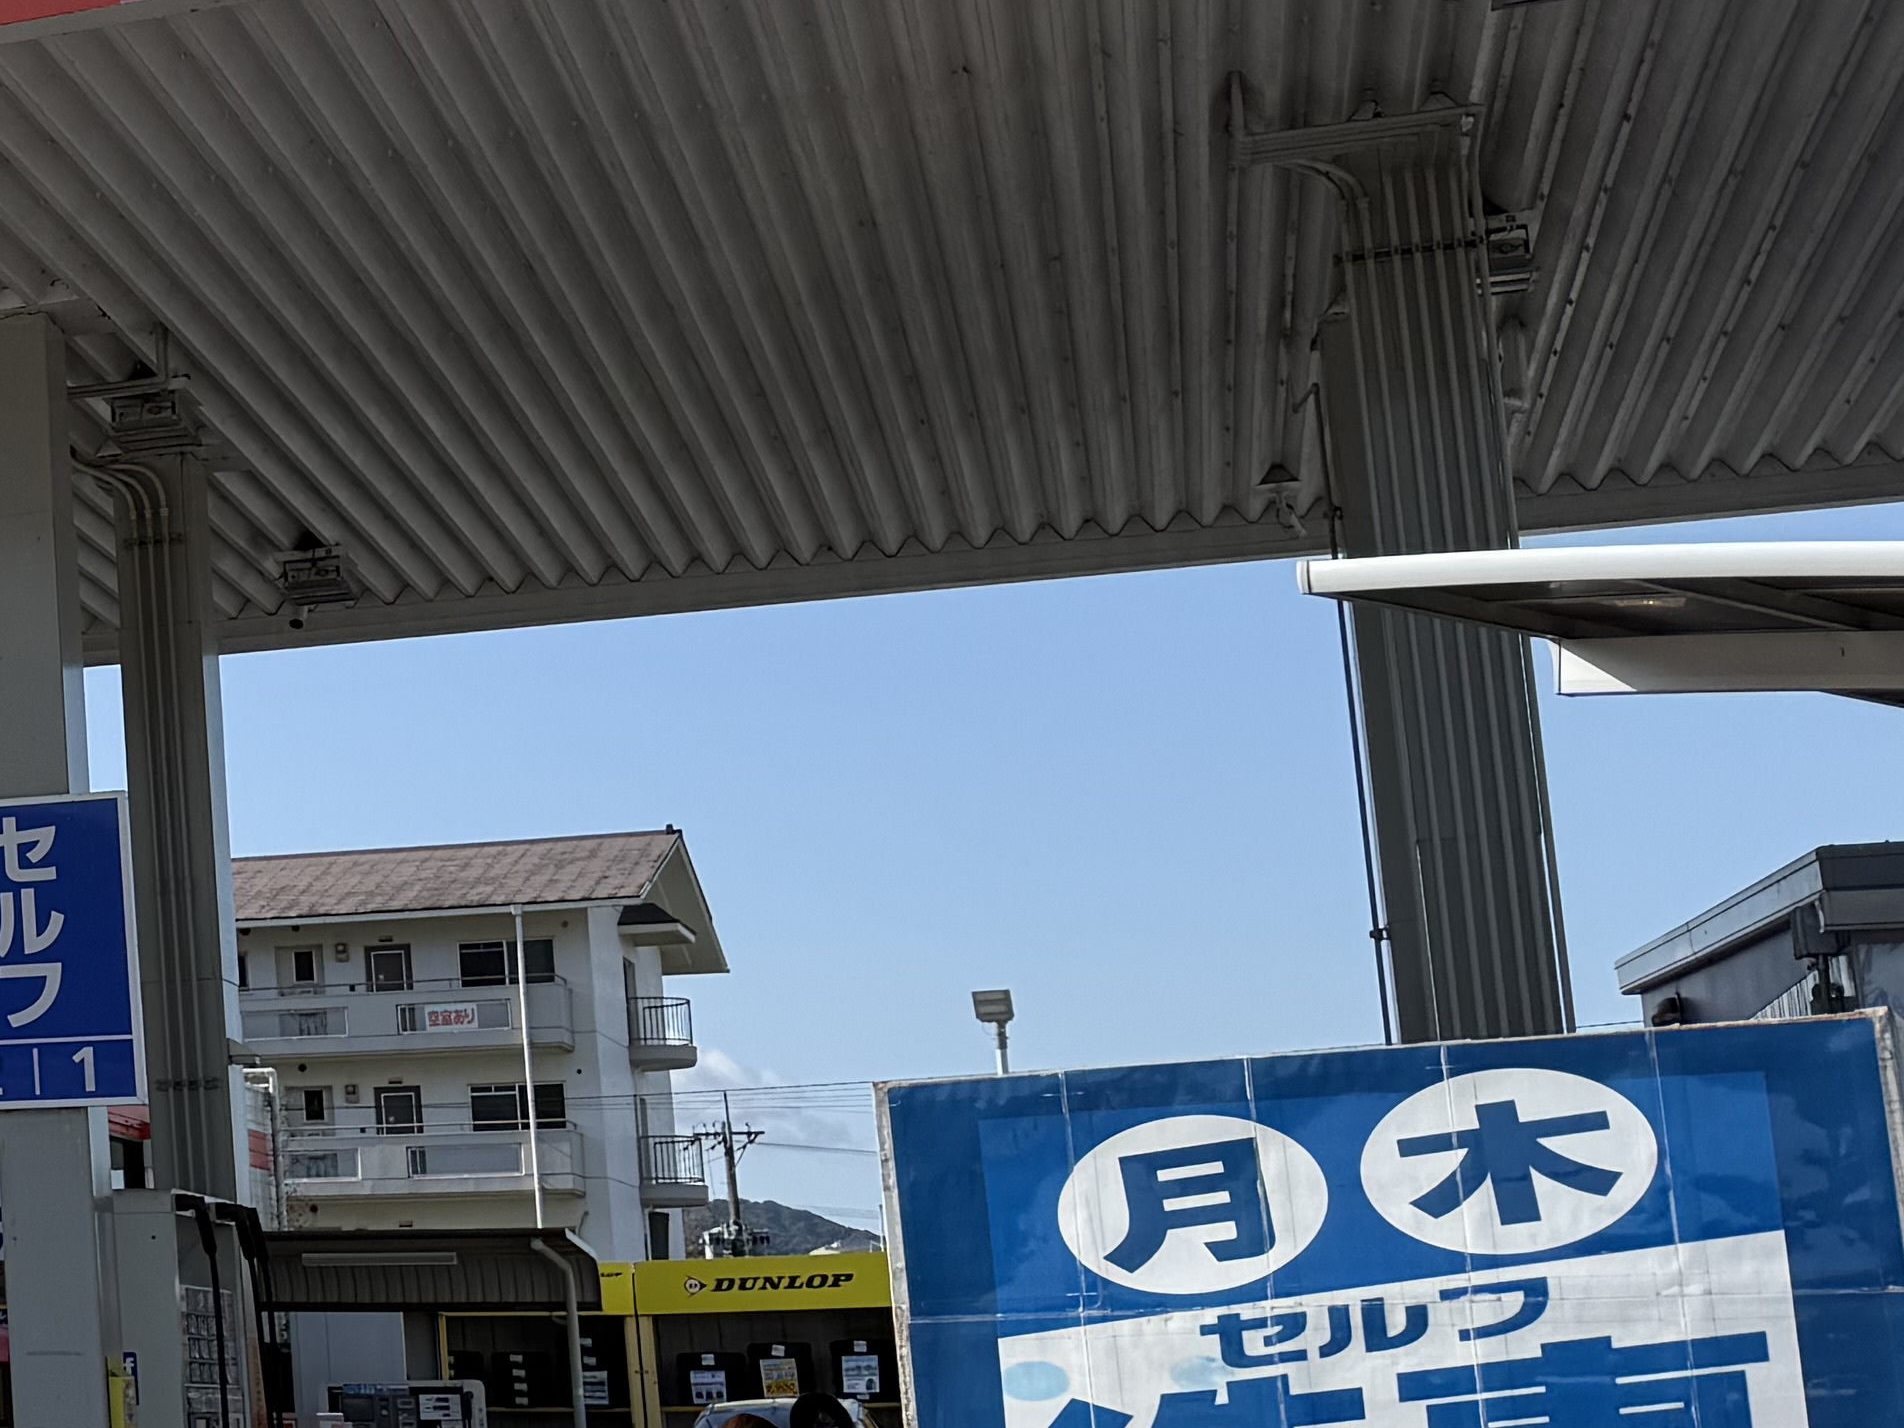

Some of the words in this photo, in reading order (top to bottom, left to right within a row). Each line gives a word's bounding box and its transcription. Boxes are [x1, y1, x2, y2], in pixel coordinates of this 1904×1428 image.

[72, 1046, 97, 1092] 1
[1103, 1135, 1276, 1275] 月
[1397, 1098, 1624, 1225] 木
[710, 1272, 854, 1292] DUNLOP
[1199, 1275, 1549, 1369] セルフ
